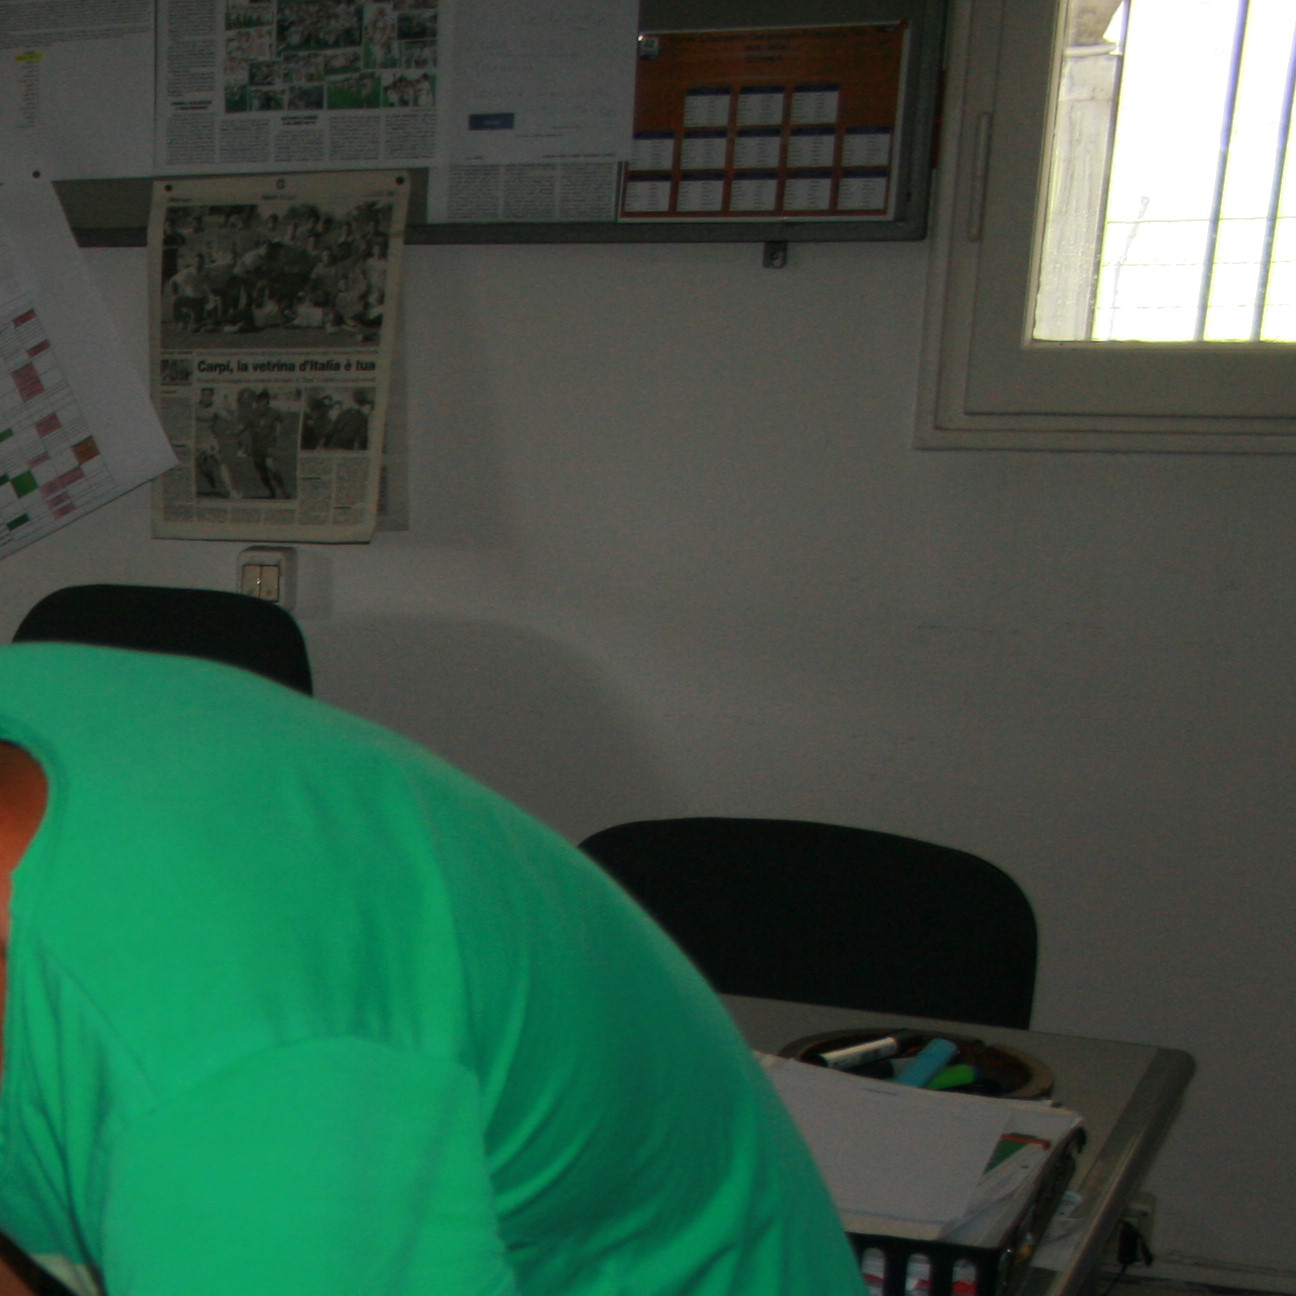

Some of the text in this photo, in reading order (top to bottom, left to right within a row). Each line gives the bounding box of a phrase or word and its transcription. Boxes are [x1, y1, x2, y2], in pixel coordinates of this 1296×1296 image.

[197, 360, 233, 375] Carpi,
[237, 360, 248, 372] la
[252, 360, 295, 372] vetrina
[299, 359, 340, 372] d'Italia
[355, 360, 376, 371] tua
